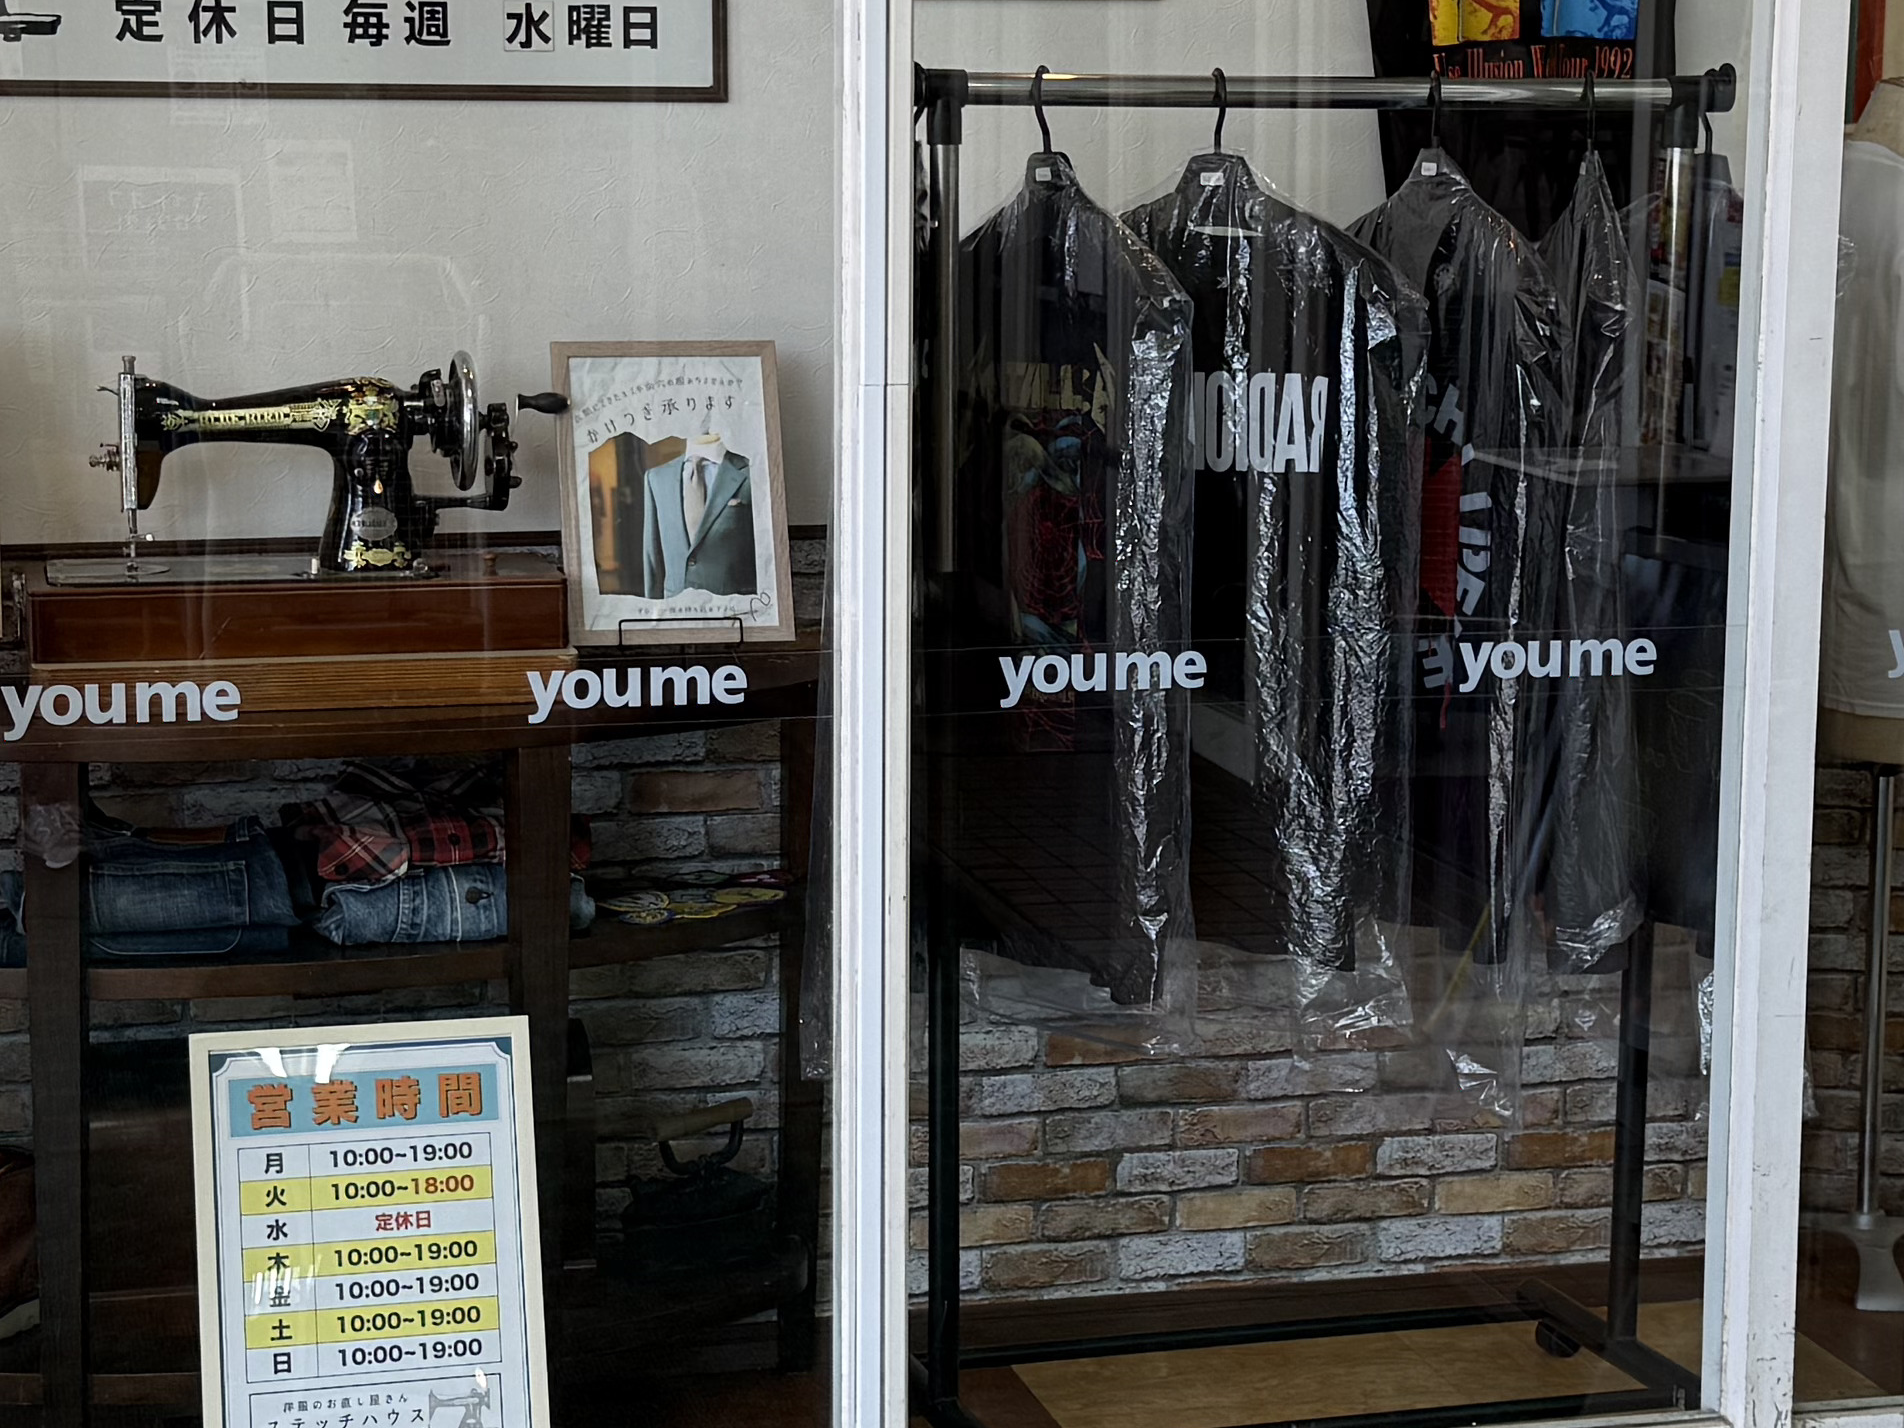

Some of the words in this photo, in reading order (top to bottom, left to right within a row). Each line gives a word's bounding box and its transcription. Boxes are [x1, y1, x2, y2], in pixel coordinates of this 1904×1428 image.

[504, 0, 661, 52] 水曜日
[586, 394, 736, 445] かけつぎ承ります
[998, 649, 1208, 709] youme
[1459, 637, 1658, 695] youme
[0, 676, 244, 742] youme
[526, 663, 749, 725] youme
[247, 1071, 484, 1131] 営業時間
[263, 1151, 285, 1176] 月
[329, 1141, 474, 1169] 10:00~19:00
[264, 1184, 288, 1209] 火
[331, 1174, 476, 1202] 10:00~18:00
[265, 1218, 289, 1242] 水
[374, 1209, 433, 1233] 定休日
[266, 1251, 291, 1274] 木
[333, 1239, 479, 1269] 10:00~19:00
[335, 1272, 481, 1302] 10:00~19:00
[269, 1317, 293, 1341] 土
[336, 1304, 482, 1335] 10:00~19:00
[271, 1351, 293, 1375] 日
[337, 1337, 483, 1368] 10:00~19:00
